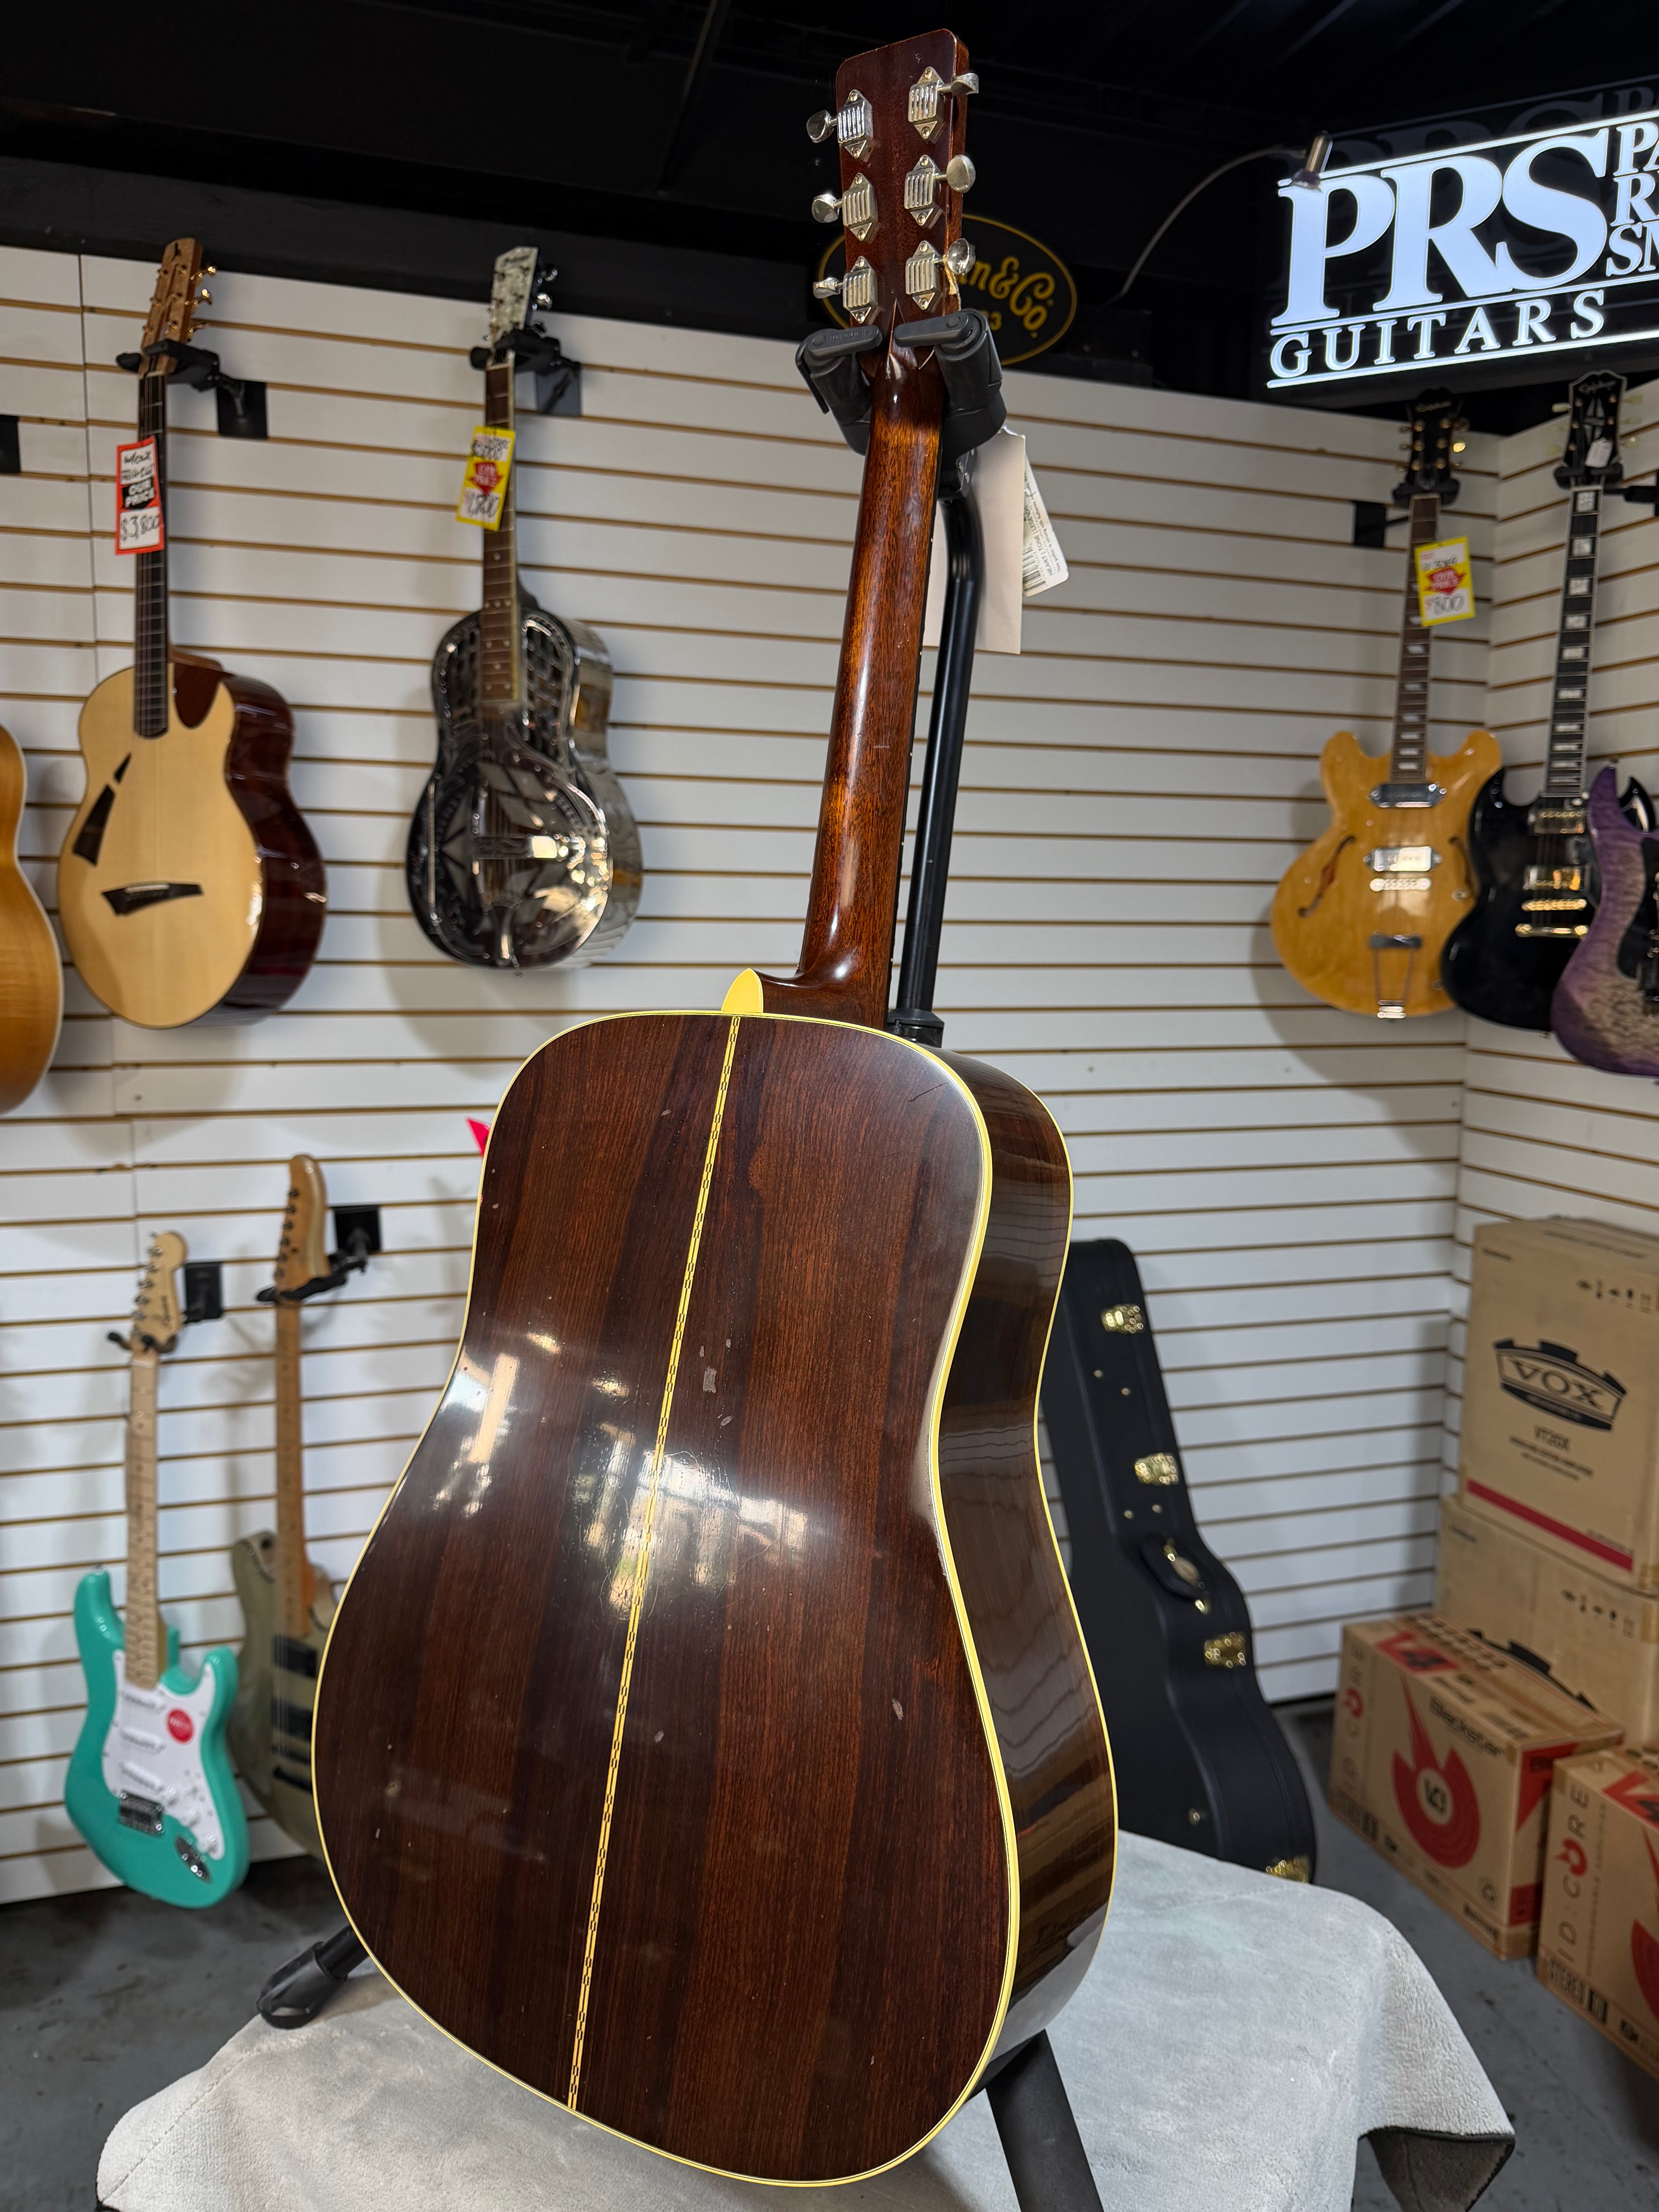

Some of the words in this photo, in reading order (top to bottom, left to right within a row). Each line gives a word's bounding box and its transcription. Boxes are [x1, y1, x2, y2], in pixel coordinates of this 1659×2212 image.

[1610, 173, 1659, 227] R
[1271, 128, 1609, 326] PRS
[1270, 290, 1604, 378] GUITARS
[1033, 534, 1044, 551] TONE
[1042, 556, 1053, 576] HEART
[1508, 1358, 1605, 1410] VOX
